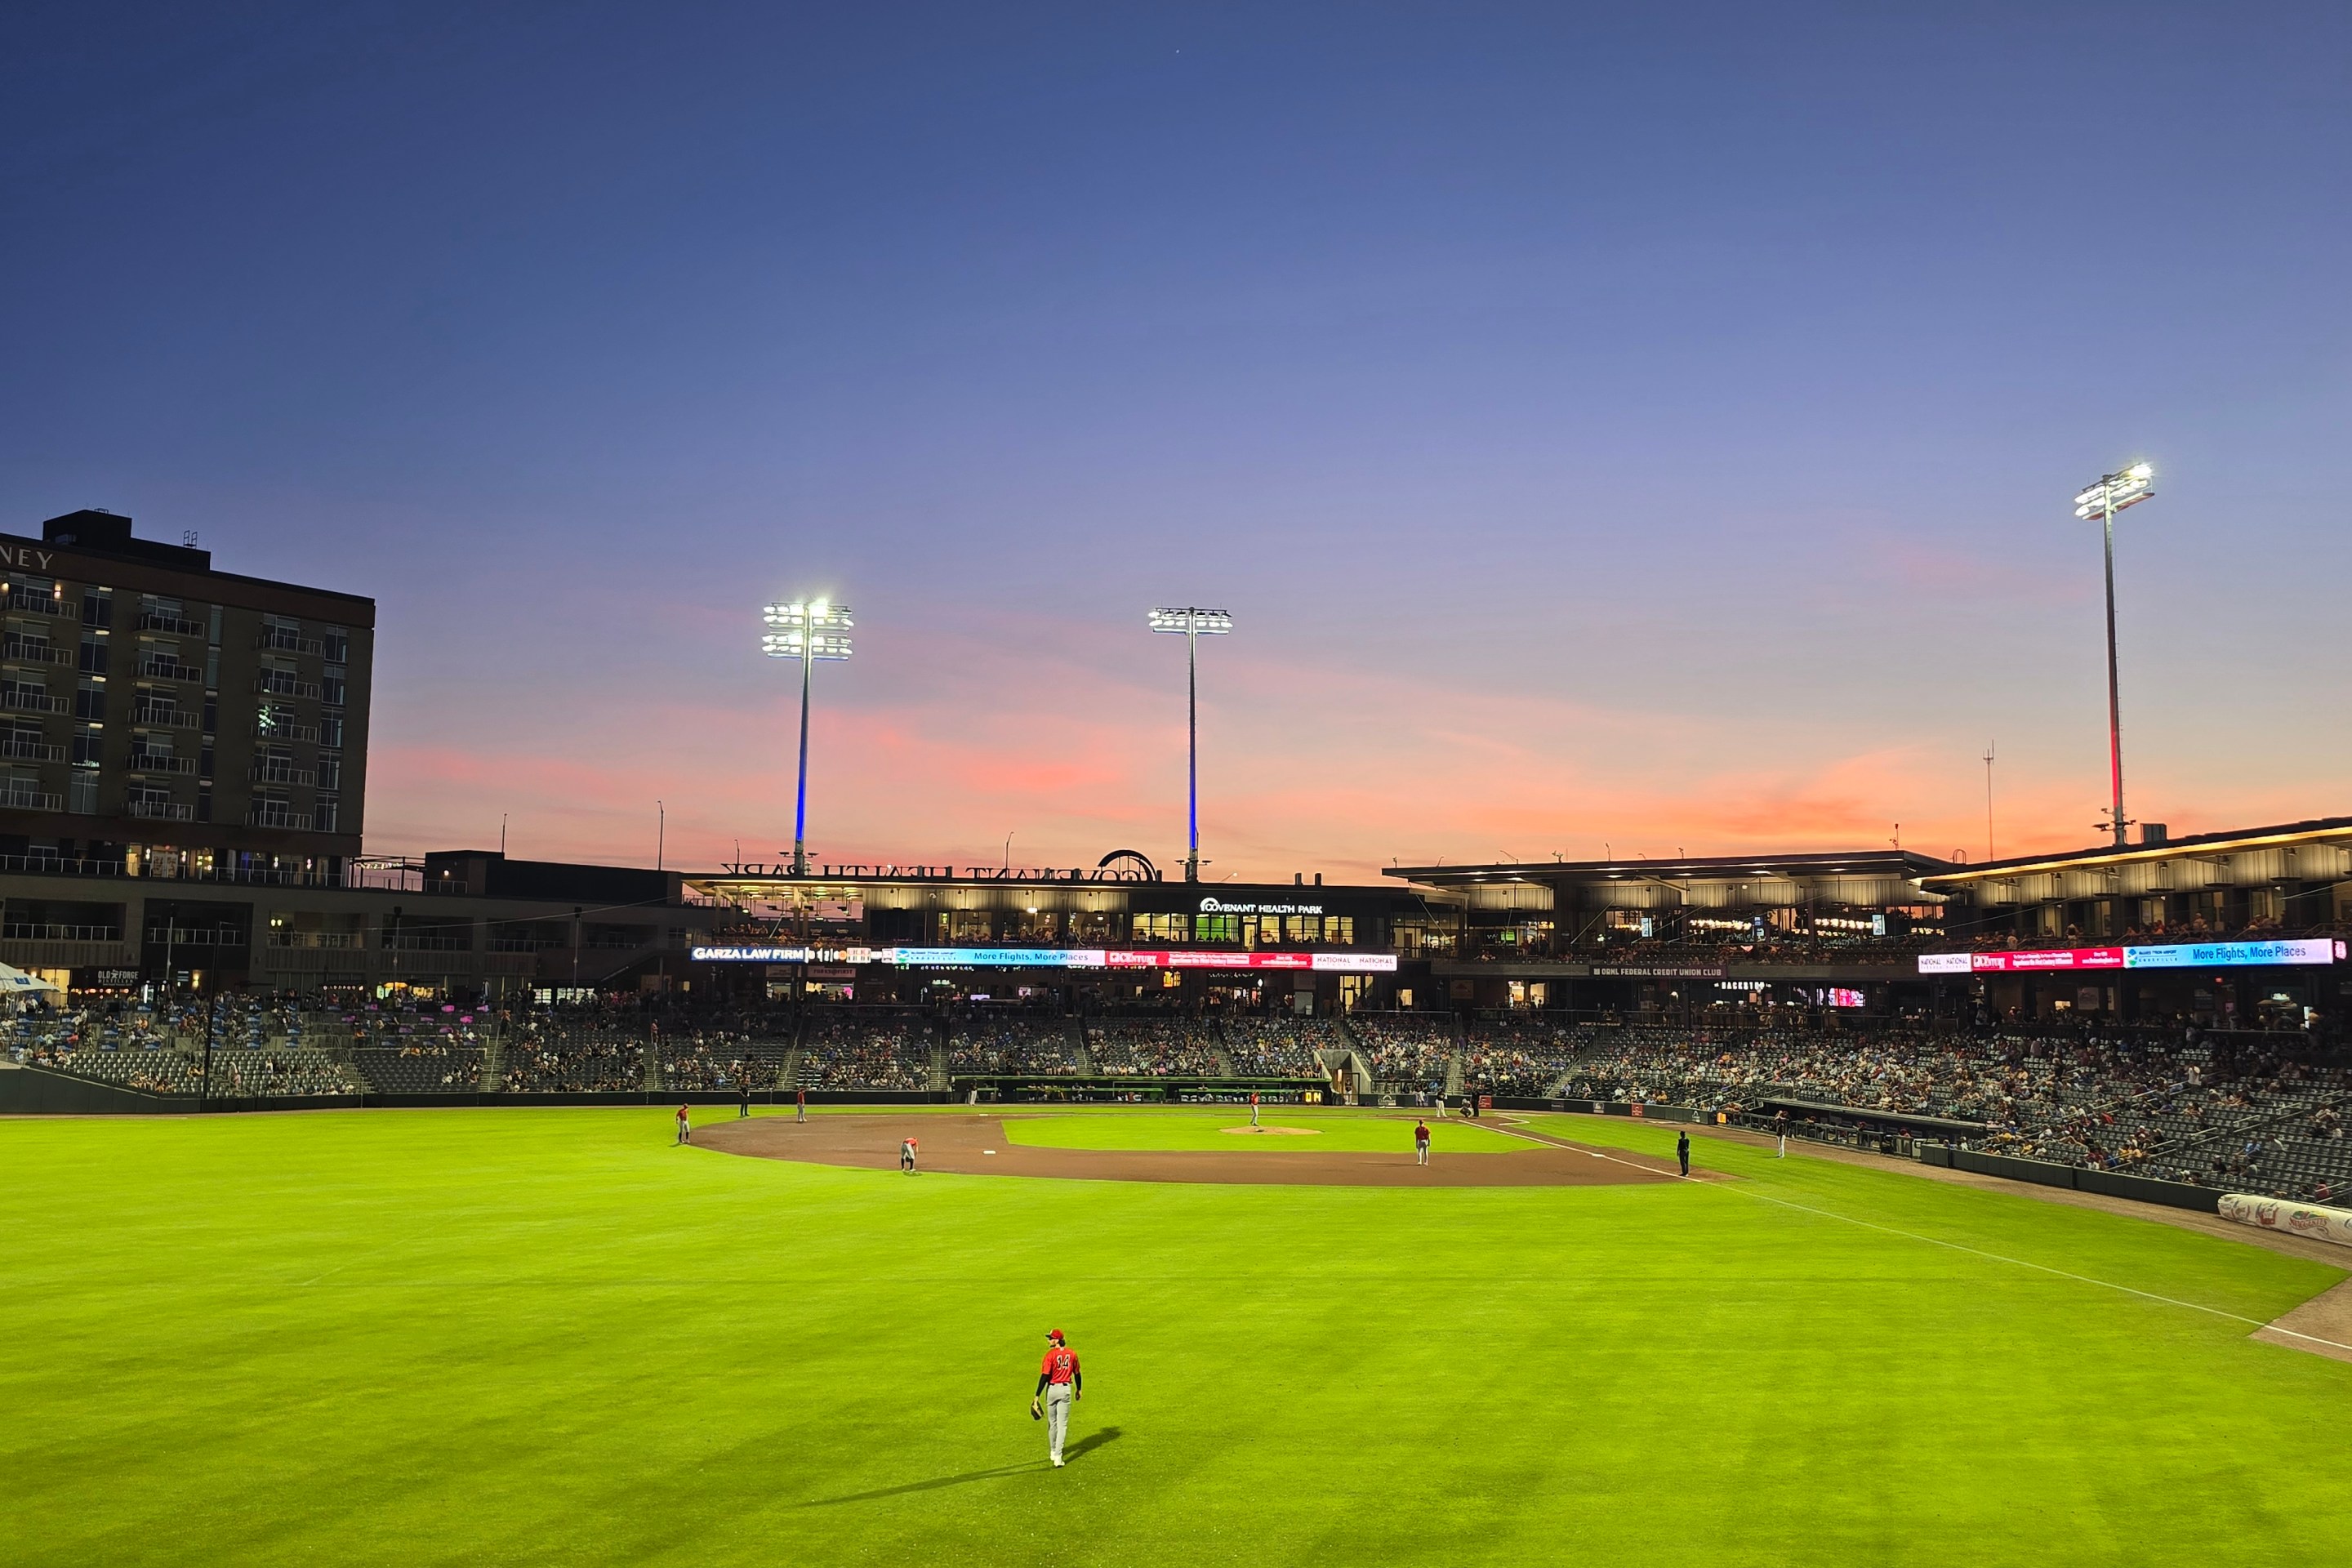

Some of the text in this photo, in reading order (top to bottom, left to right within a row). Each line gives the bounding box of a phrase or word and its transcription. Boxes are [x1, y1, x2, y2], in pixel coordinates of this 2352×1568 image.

[0, 545, 53, 570] NEY
[1205, 903, 1323, 914] COVENANT HEALTH PARK
[693, 947, 742, 960] GARZA
[742, 948, 772, 960] LAW
[773, 948, 804, 960] FIRM
[974, 952, 997, 960] More
[1000, 952, 1032, 962] Flights,
[1060, 953, 1089, 961] Places
[2193, 946, 2306, 961] More Flights, More Places
[97, 970, 139, 979] OLD FORGE
[1653, 968, 1677, 976] CREDIT
[1057, 1354, 1071, 1370] 14
